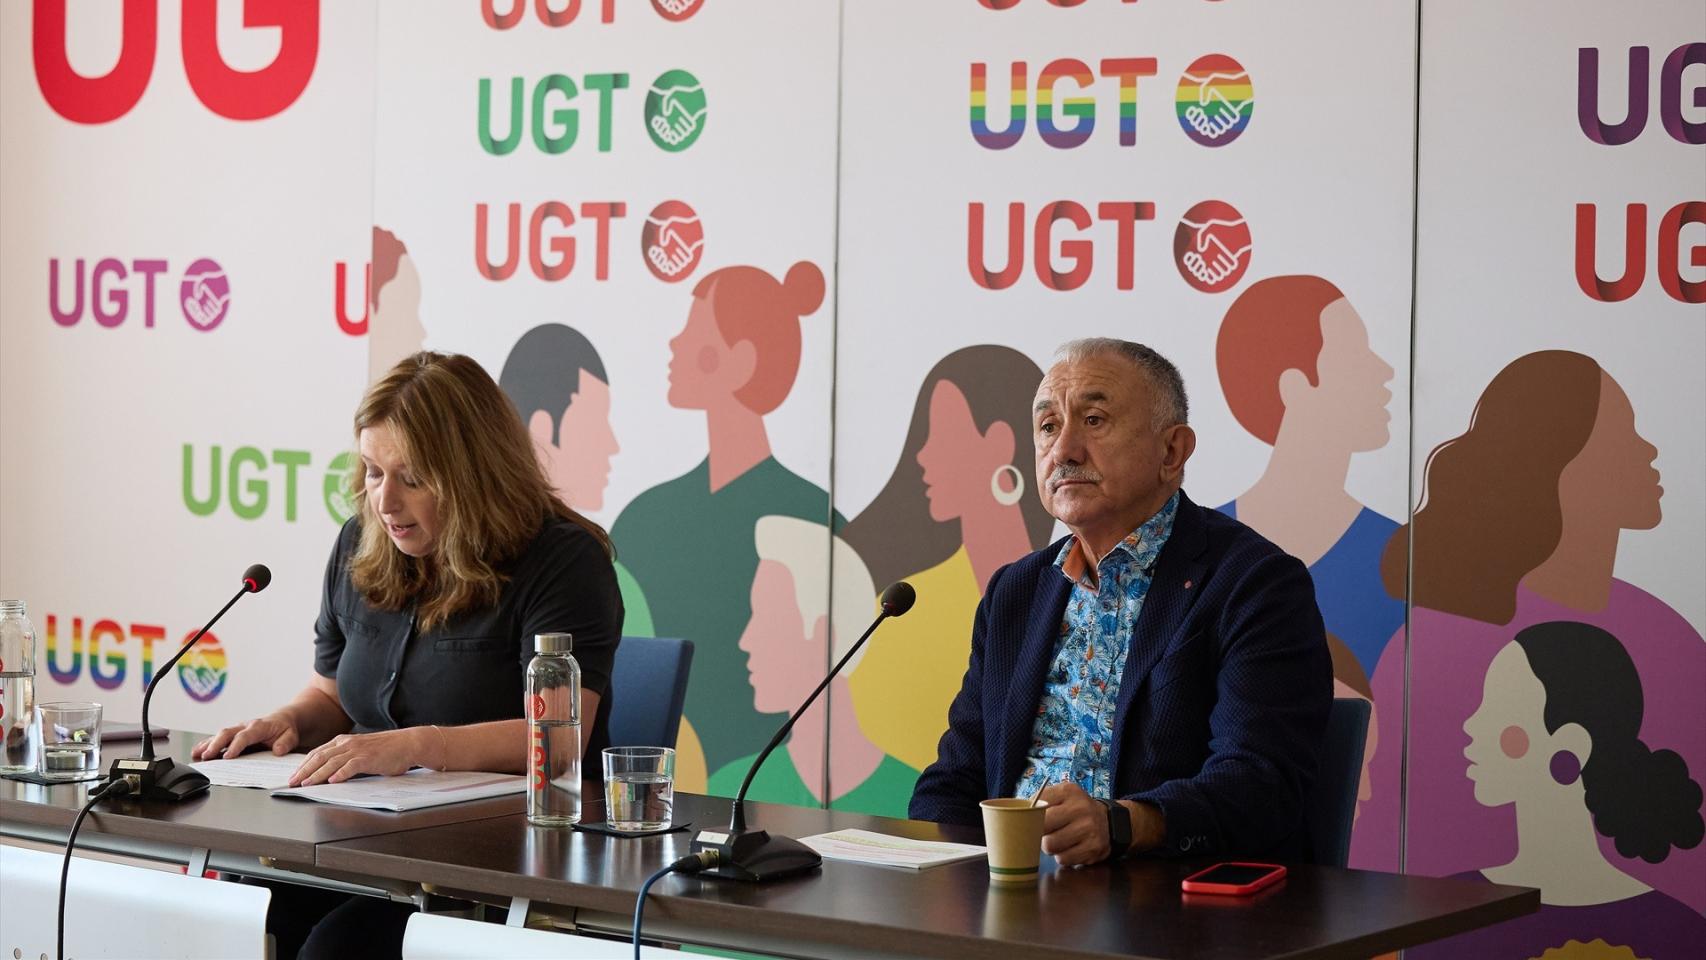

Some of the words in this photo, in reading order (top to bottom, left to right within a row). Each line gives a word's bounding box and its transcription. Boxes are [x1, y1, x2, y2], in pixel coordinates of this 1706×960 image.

[478, 73, 630, 155] UGT
[970, 57, 1158, 150] UGT
[475, 201, 627, 282] UGT
[967, 200, 1156, 292] UGT
[48, 257, 168, 329] UGT
[182, 444, 311, 522] UGT
[46, 614, 166, 694] UGT
